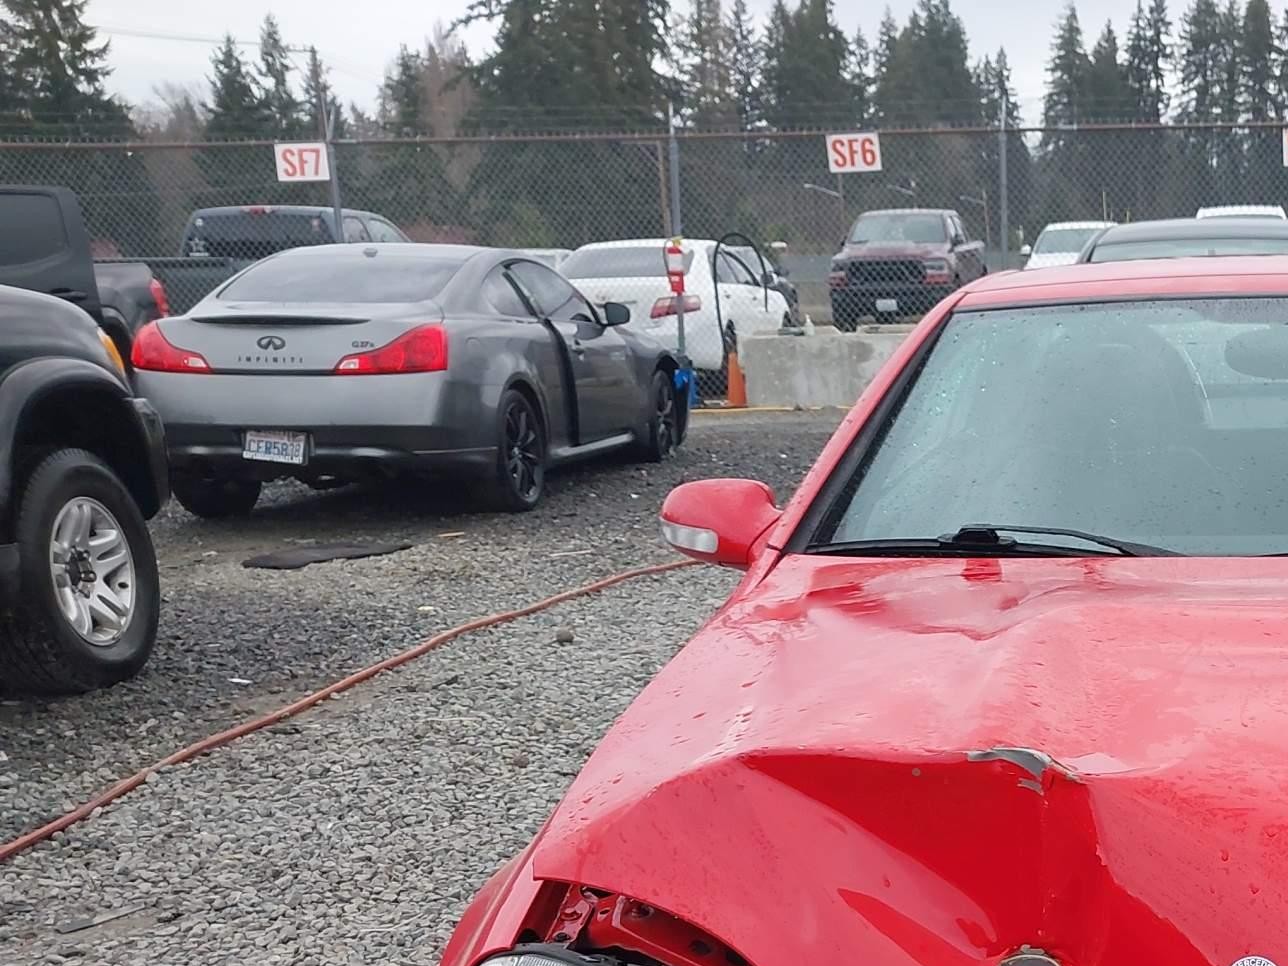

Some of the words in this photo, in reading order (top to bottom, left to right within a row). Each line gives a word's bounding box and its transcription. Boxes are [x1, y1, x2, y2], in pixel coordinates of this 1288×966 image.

[282, 148, 321, 177] SF7
[831, 138, 877, 168] SF6
[238, 355, 304, 363] INFINITI
